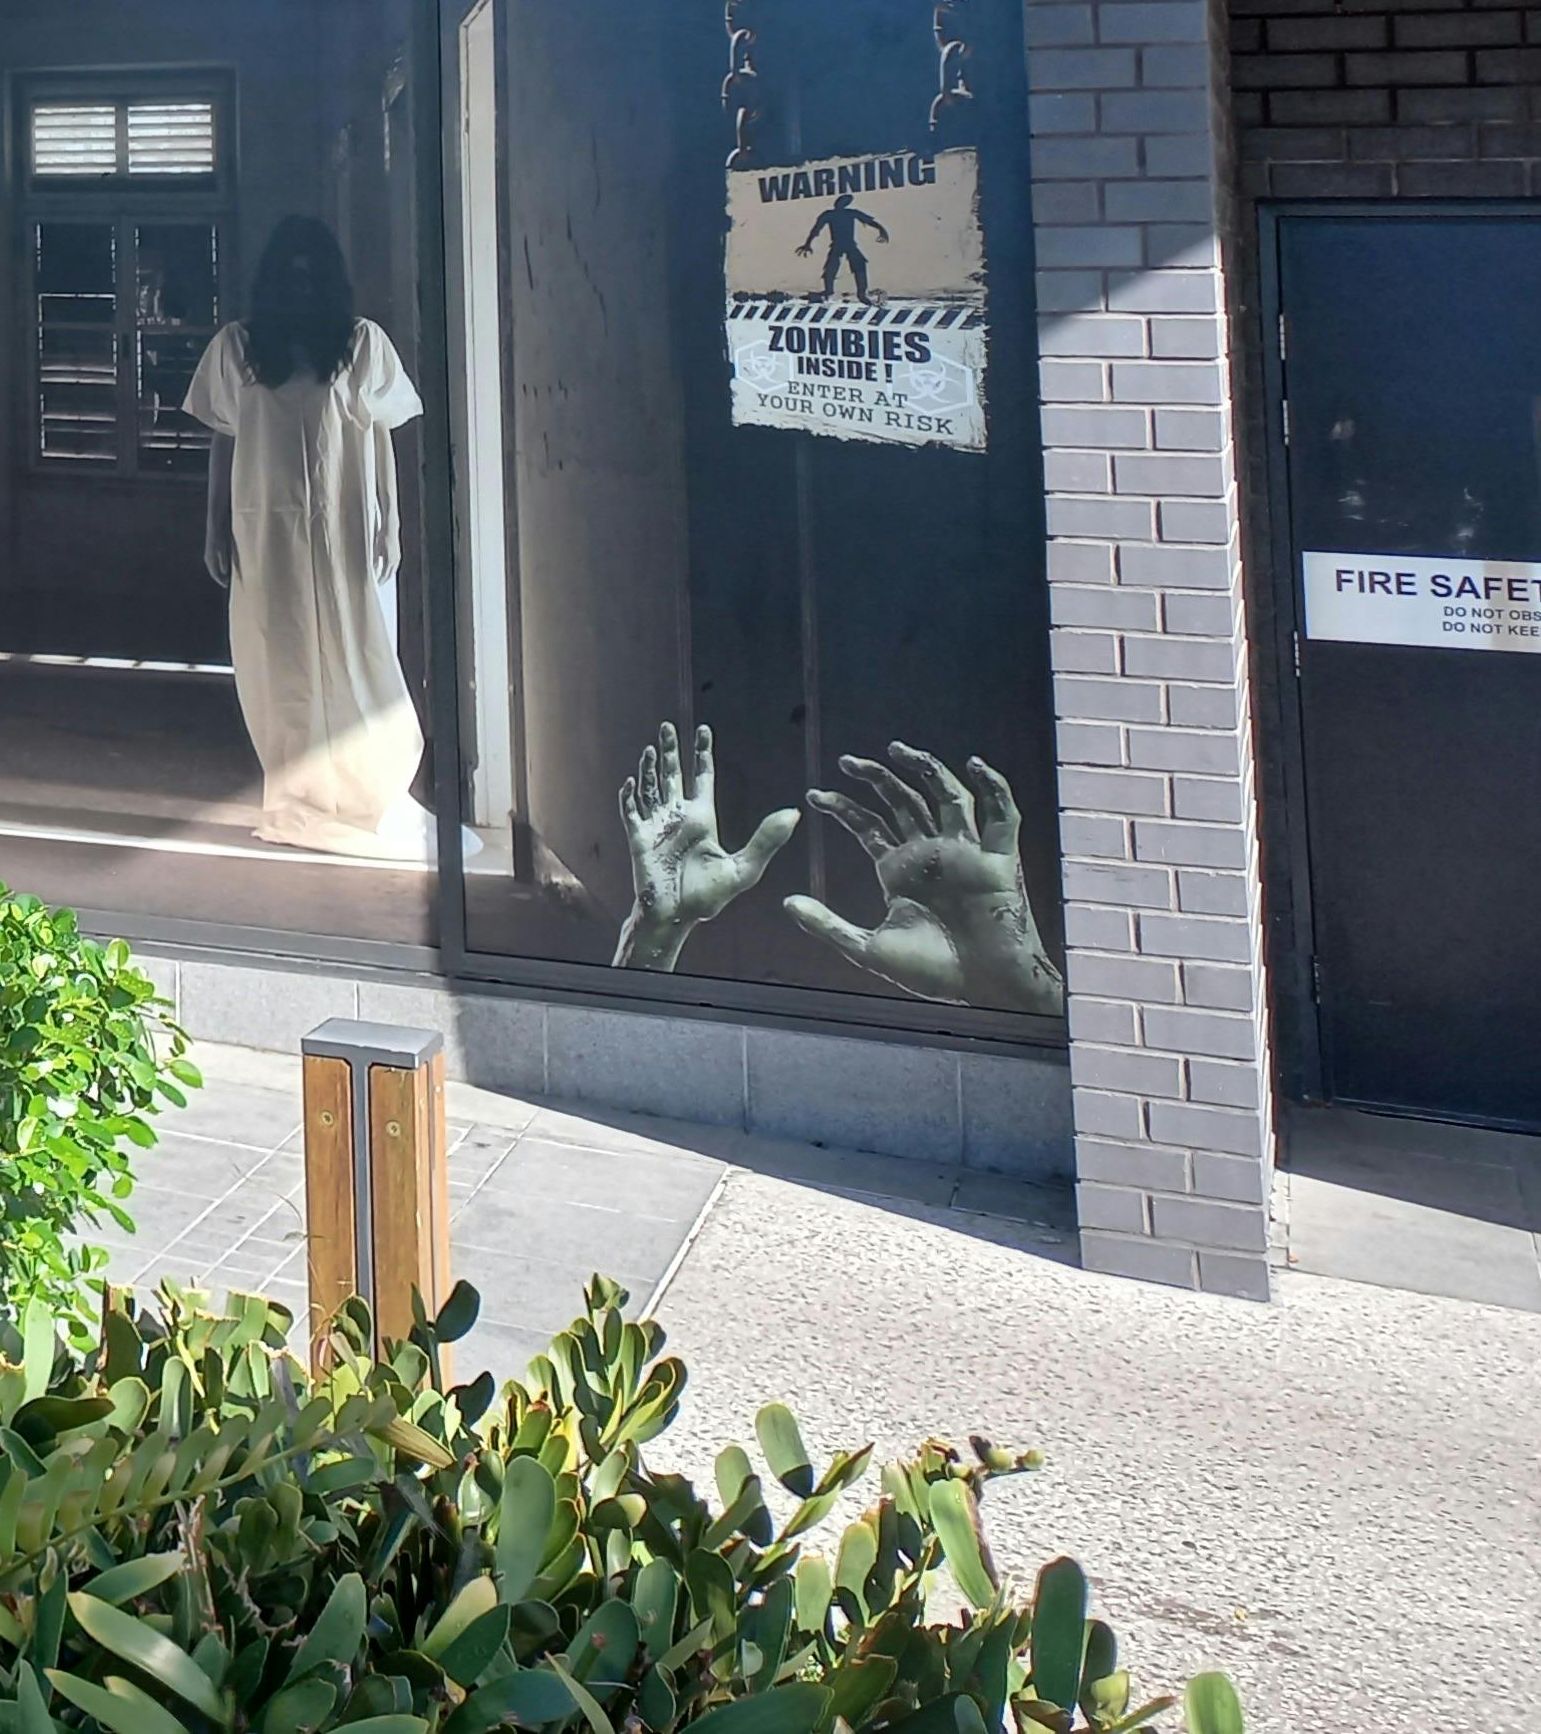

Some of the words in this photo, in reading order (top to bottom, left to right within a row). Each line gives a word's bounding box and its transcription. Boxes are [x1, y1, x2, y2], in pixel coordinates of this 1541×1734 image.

[757, 157, 937, 203] WARNING
[768, 325, 932, 363] ZOMBIES
[787, 380, 865, 404] ENTER
[874, 390, 908, 409] AT
[756, 392, 814, 415] YOUR
[822, 403, 874, 423] OWN
[885, 410, 954, 436] RISK
[1335, 569, 1418, 597] FIRE
[1443, 606, 1467, 618] DO
[1471, 607, 1505, 620] NOT
[1442, 621, 1466, 633] DO
[1470, 623, 1504, 635] NOT
